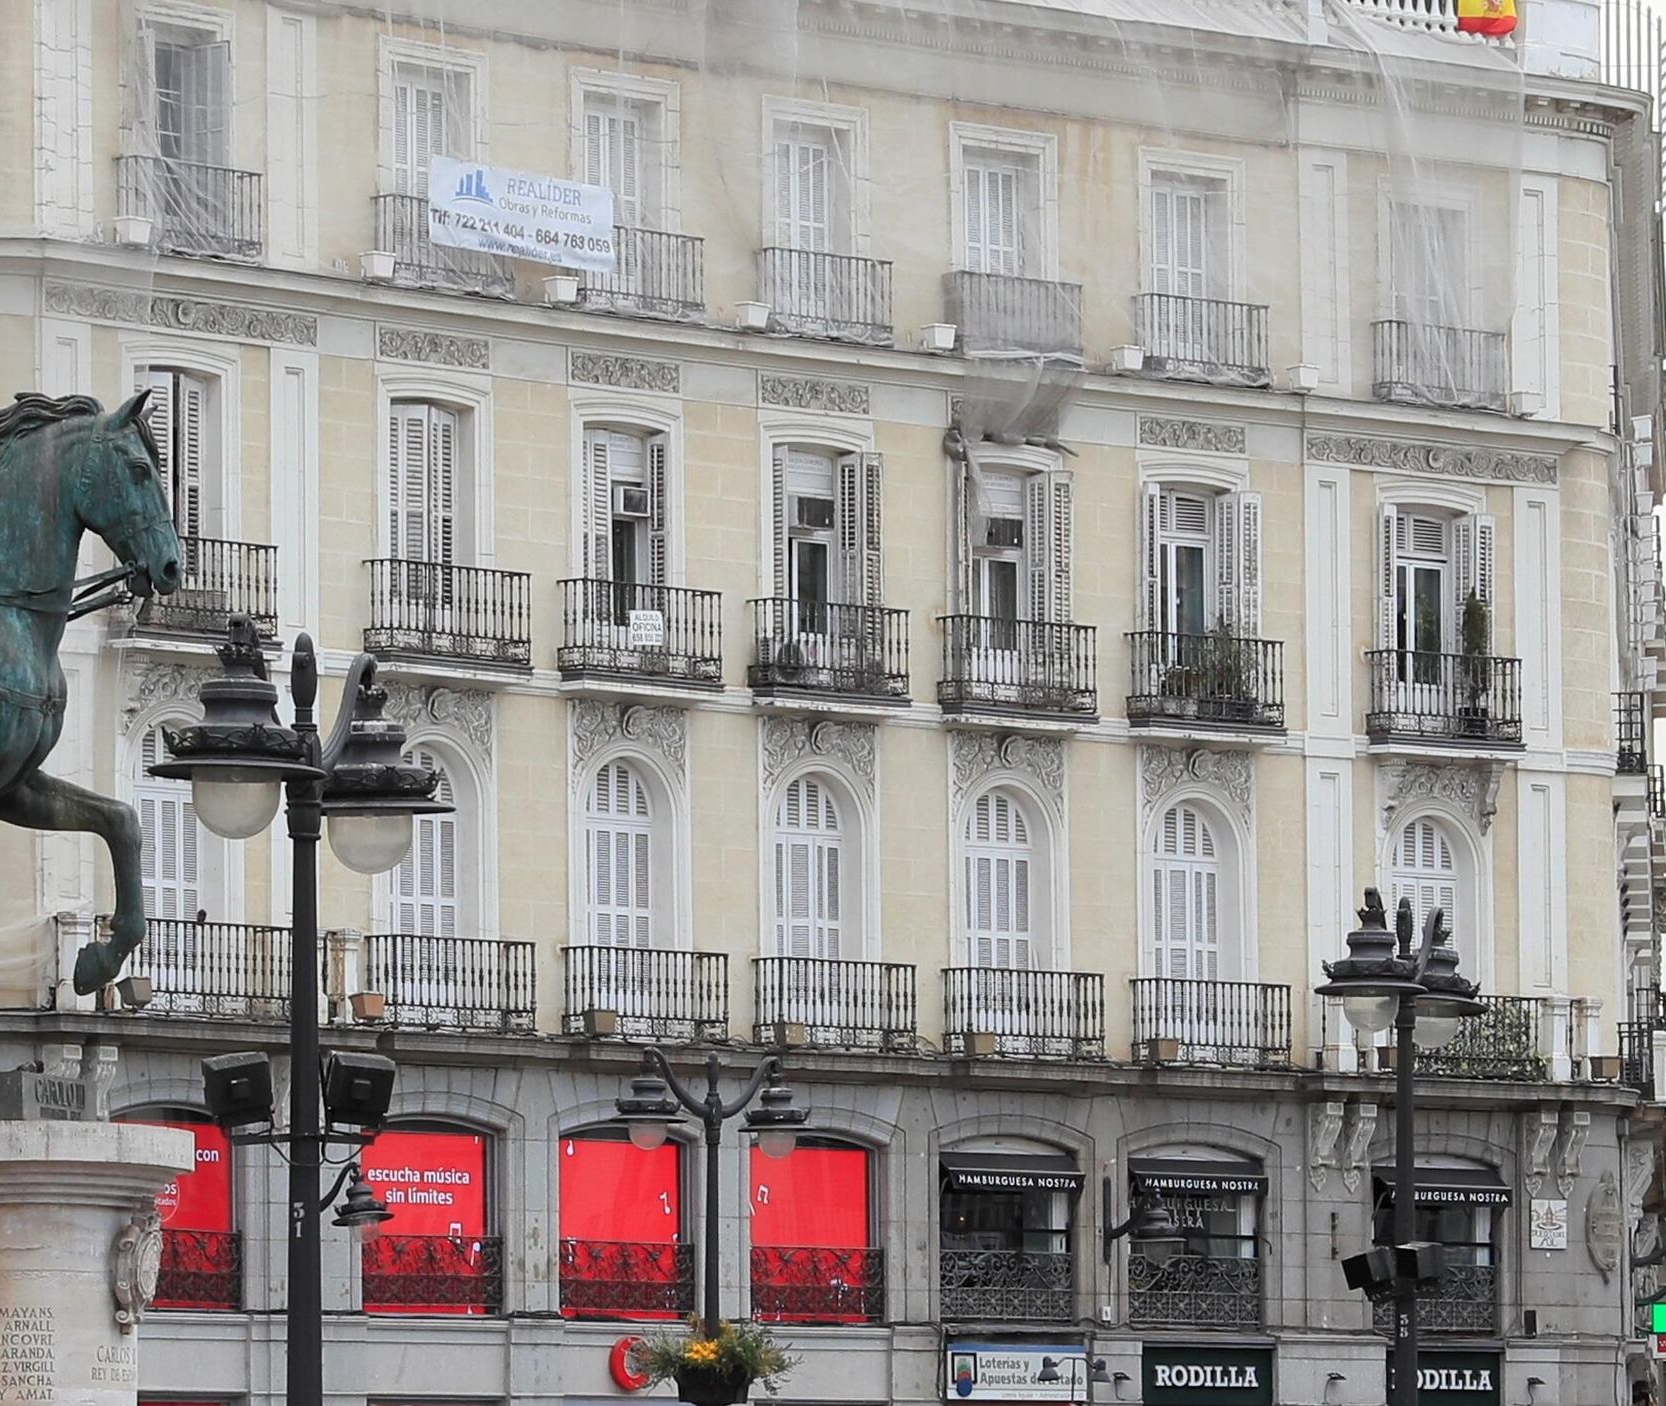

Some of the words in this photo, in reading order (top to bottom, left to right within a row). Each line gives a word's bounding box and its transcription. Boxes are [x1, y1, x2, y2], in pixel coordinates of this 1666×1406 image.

[507, 177, 582, 207] REALÍDER
[498, 197, 530, 214] Obras
[533, 206, 538, 218] y
[541, 206, 592, 225] Reformas
[455, 213, 477, 231] 722
[503, 222, 525, 240] 404
[536, 228, 559, 246] 664
[563, 233, 585, 248] 763
[588, 238, 610, 254] 059
[196, 1149, 219, 1163] con
[367, 1168, 421, 1184] escucha
[424, 1167, 470, 1184] música
[958, 1174, 1034, 1188] HAMBURGUESA
[1037, 1177, 1077, 1189] NOSTRA
[1144, 1177, 1219, 1190] HAMBURGUESA
[1221, 1179, 1259, 1191] NOSTRA
[385, 1188, 405, 1203] sin
[408, 1187, 453, 1206] límites
[1469, 1192, 1509, 1203] NOSTRA
[979, 1356, 1021, 1370] Loterías
[1023, 1359, 1030, 1371] y
[980, 1373, 1028, 1386] Apuestas
[1154, 1364, 1260, 1388] RODILLA
